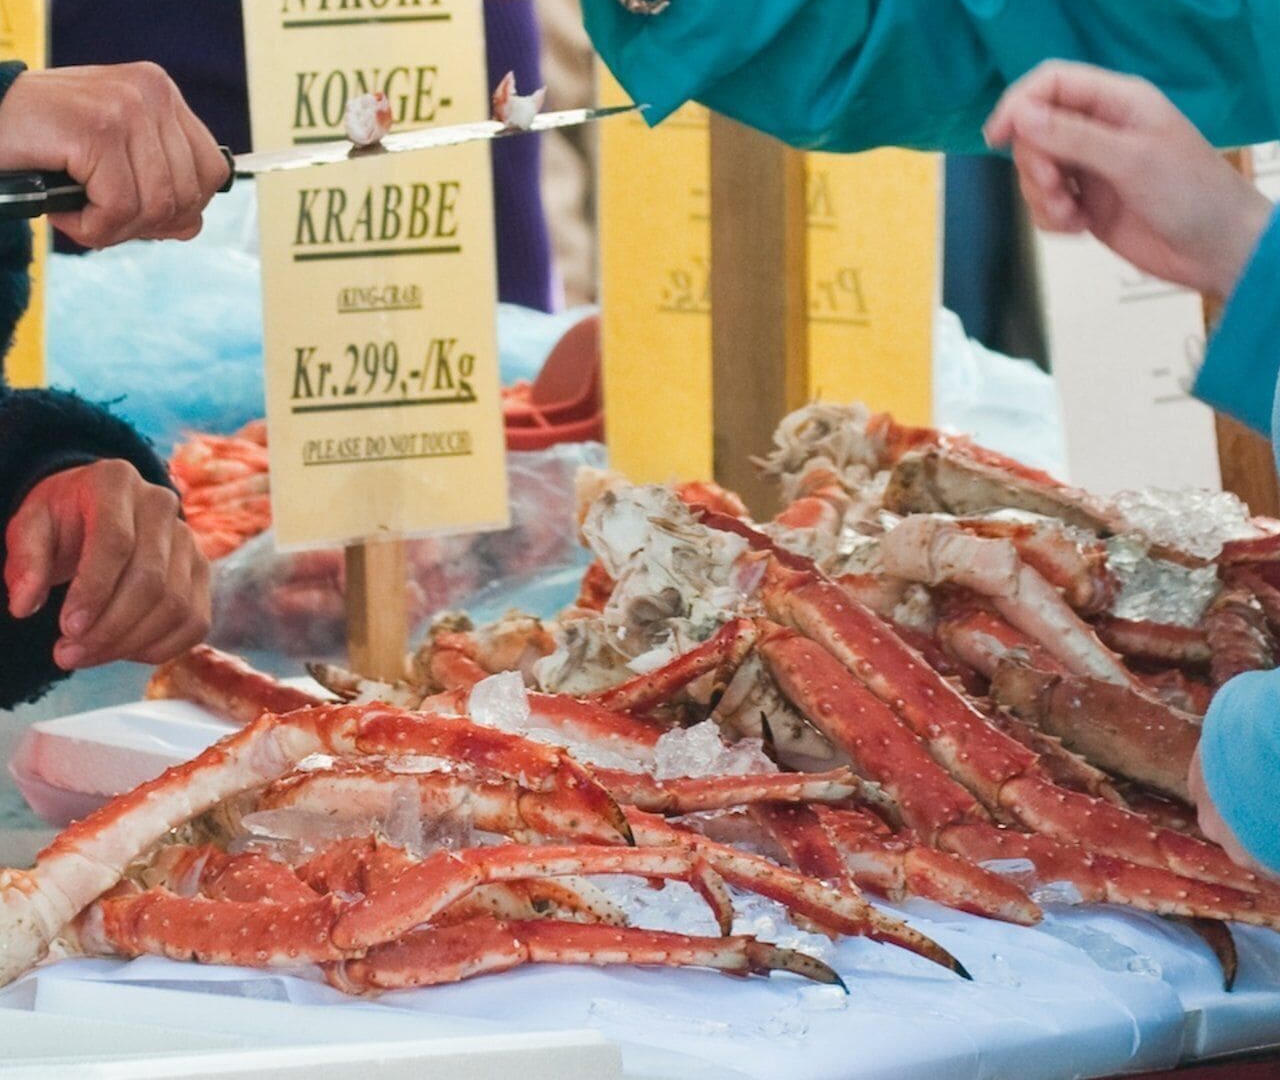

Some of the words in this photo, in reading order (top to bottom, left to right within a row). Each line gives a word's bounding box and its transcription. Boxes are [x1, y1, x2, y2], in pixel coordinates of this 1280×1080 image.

[293, 181, 460, 246] KRABBE
[291, 337, 476, 399] Kr.299,-/Kg
[365, 435, 386, 457] DO
[389, 433, 418, 456] NOT
